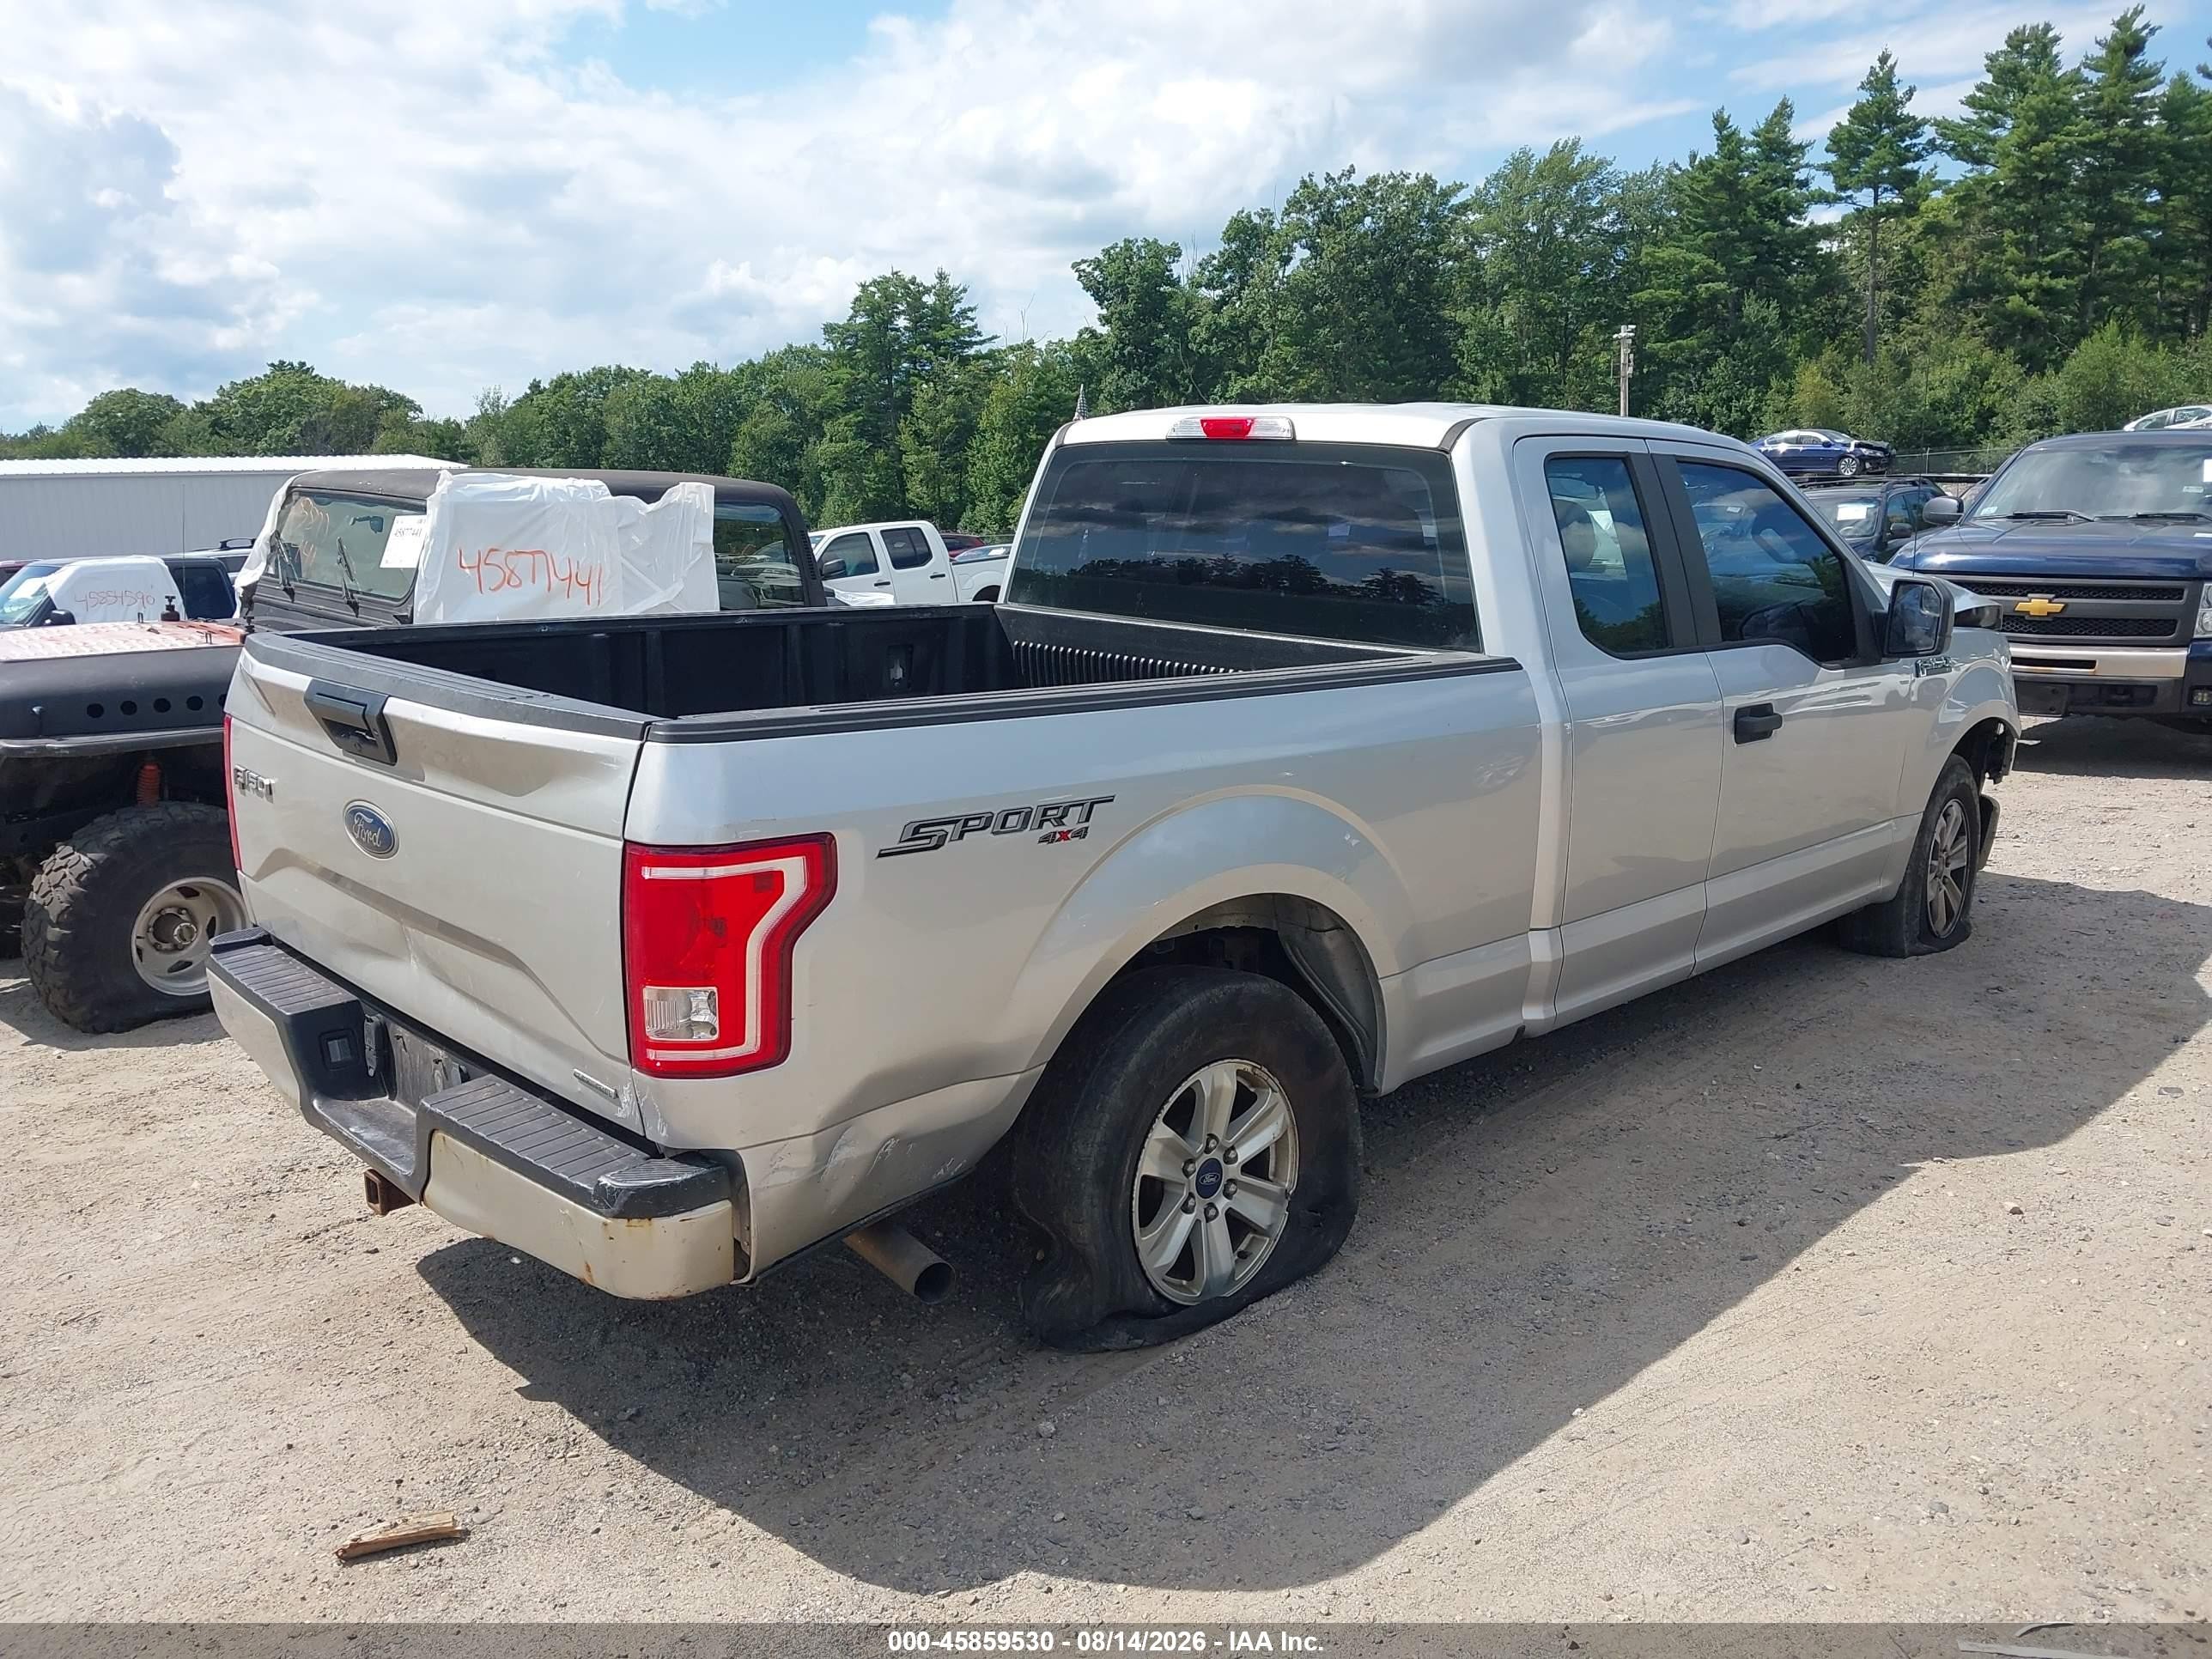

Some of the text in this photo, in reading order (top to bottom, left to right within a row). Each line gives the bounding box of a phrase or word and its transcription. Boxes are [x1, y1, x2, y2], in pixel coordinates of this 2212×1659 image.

[74, 589, 156, 612] 45854590
[457, 547, 603, 607] 45877441
[352, 811, 385, 848] Ford
[874, 794, 1116, 859] SPORT
